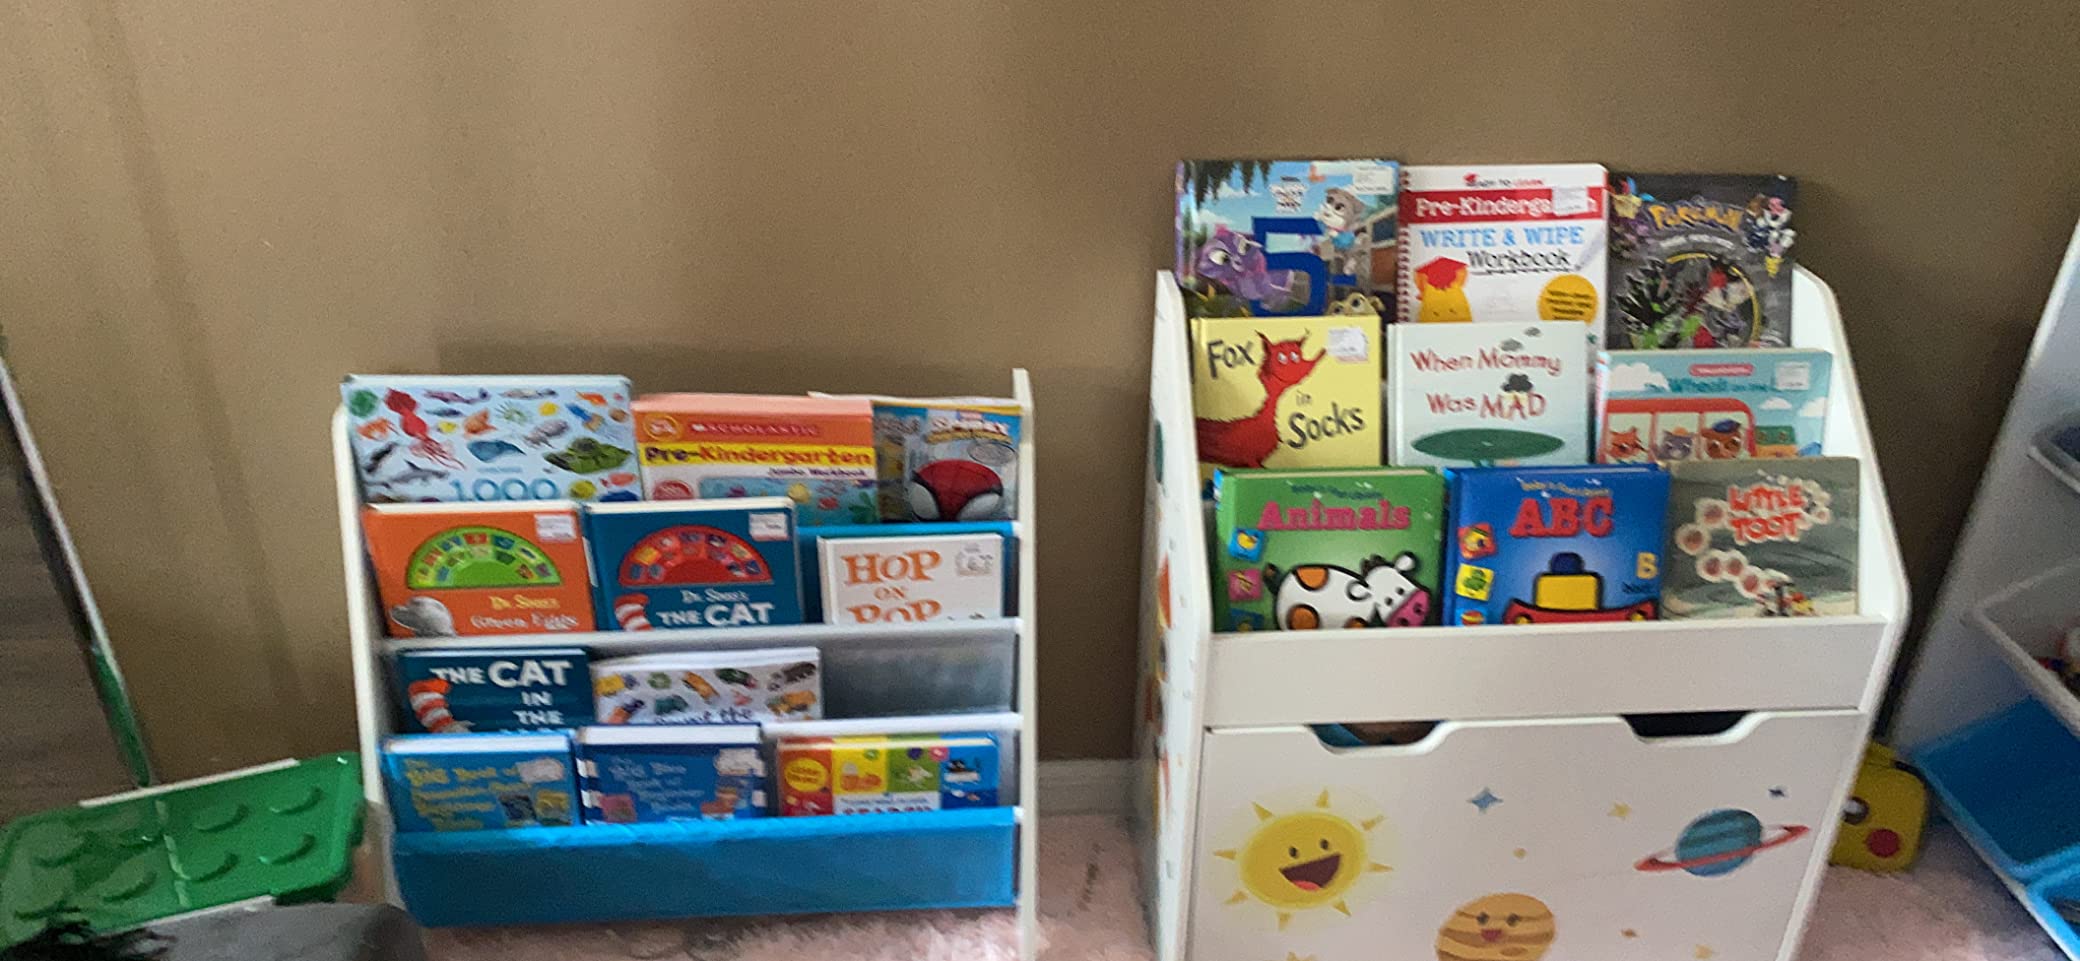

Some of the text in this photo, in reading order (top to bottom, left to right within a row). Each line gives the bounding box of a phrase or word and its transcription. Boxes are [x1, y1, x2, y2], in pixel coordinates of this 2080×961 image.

[1419, 225, 1585, 248] WRITE & WIPE
[1466, 248, 1571, 269] Workbook
[1207, 339, 1256, 379] Fox
[1410, 347, 1562, 377] When Mommy
[1296, 389, 1313, 406] in
[1426, 389, 1548, 420] Was MAD
[705, 423, 820, 435] SCHOLASTIC
[1287, 401, 1366, 449] Socks
[645, 446, 873, 465] Pre-Kindergarten
[1727, 484, 1806, 512] LITTLE
[1257, 498, 1412, 531] Animals
[1508, 496, 1615, 538] ABC
[1728, 511, 1803, 544] TOOT
[840, 549, 942, 585] HOP
[1636, 551, 1658, 580] B
[655, 602, 775, 628] THE CAT
[429, 659, 573, 688] THE CAT
[520, 690, 554, 707] IN
[513, 709, 566, 726] THE
